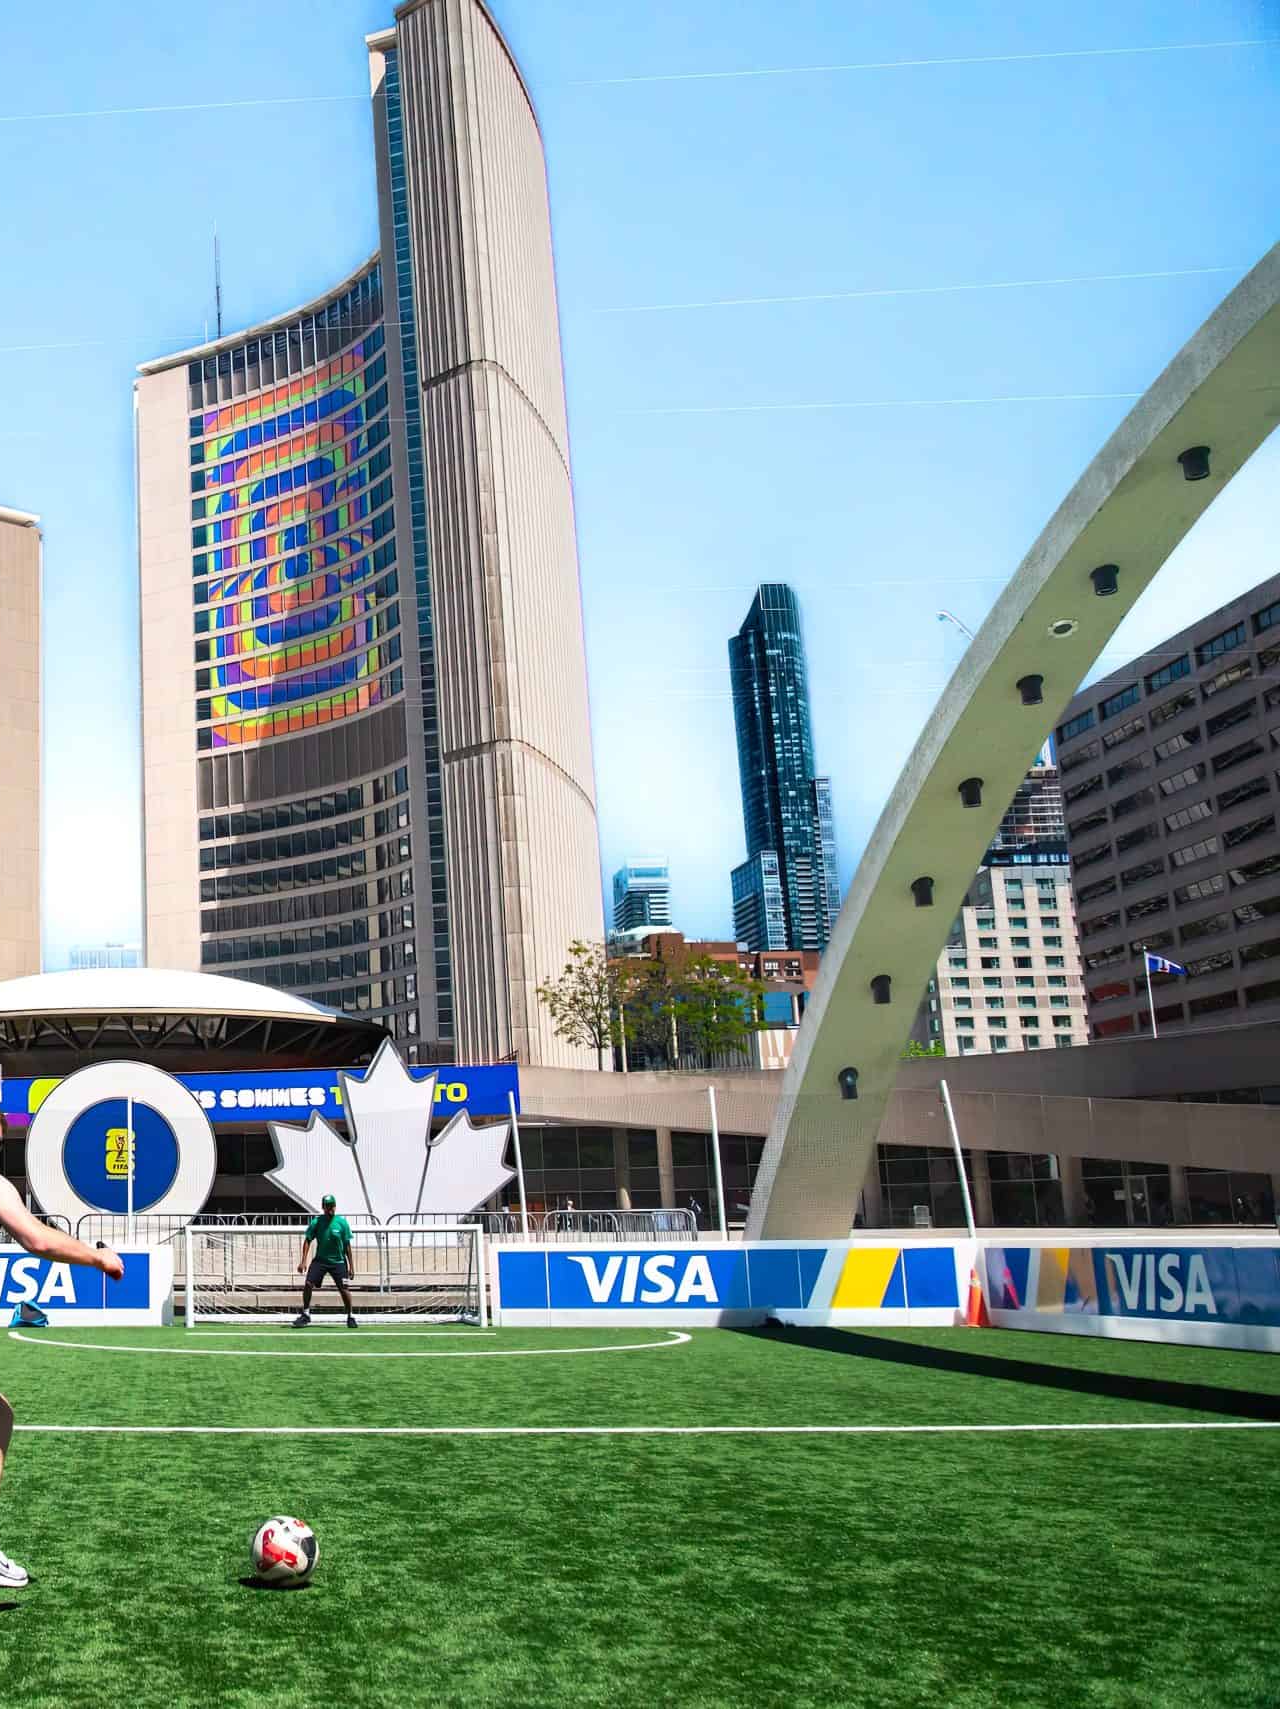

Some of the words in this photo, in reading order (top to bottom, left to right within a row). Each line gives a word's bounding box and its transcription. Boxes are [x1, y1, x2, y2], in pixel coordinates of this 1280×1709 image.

[220, 1087, 326, 1109] SOMMES
[567, 1254, 720, 1304] VISA
[1105, 1253, 1218, 1314] VISA
